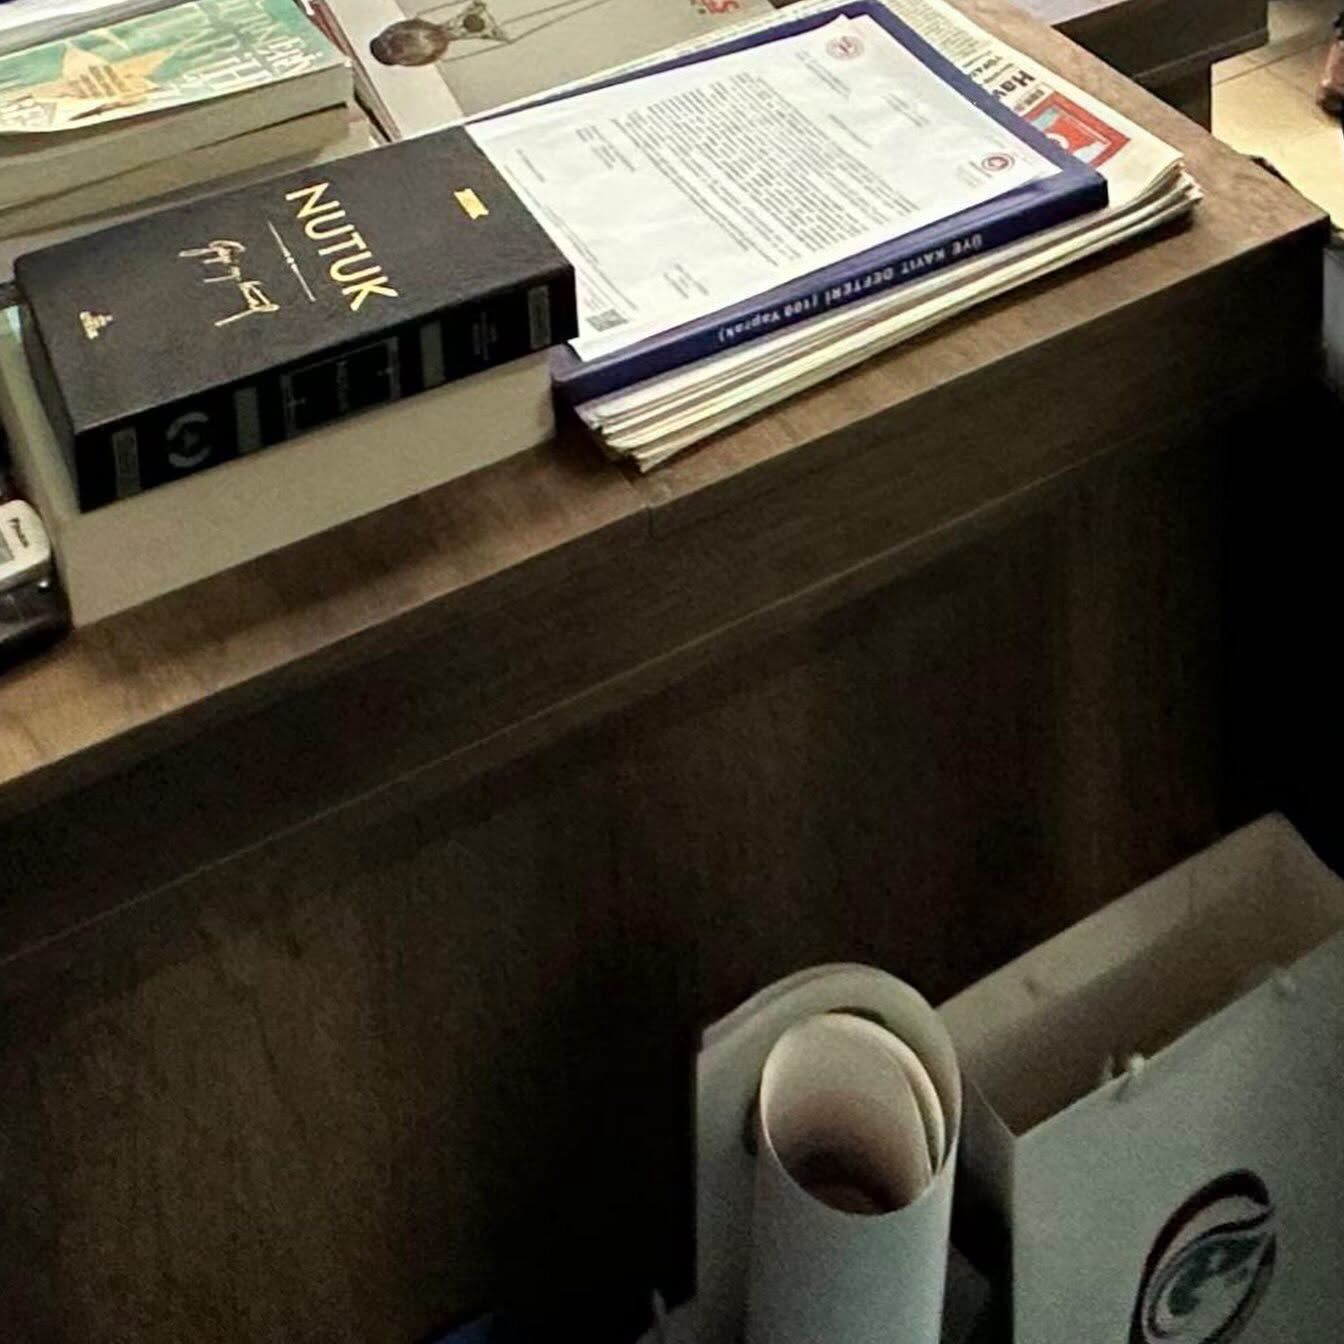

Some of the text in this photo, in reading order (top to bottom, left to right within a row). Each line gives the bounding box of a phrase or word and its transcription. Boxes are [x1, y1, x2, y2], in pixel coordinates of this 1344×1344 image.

[285, 182, 399, 311] NUTUK
[900, 244, 946, 275] KAYIT
[952, 233, 983, 256] ÜYE
[825, 264, 894, 299] DEFTERİ
